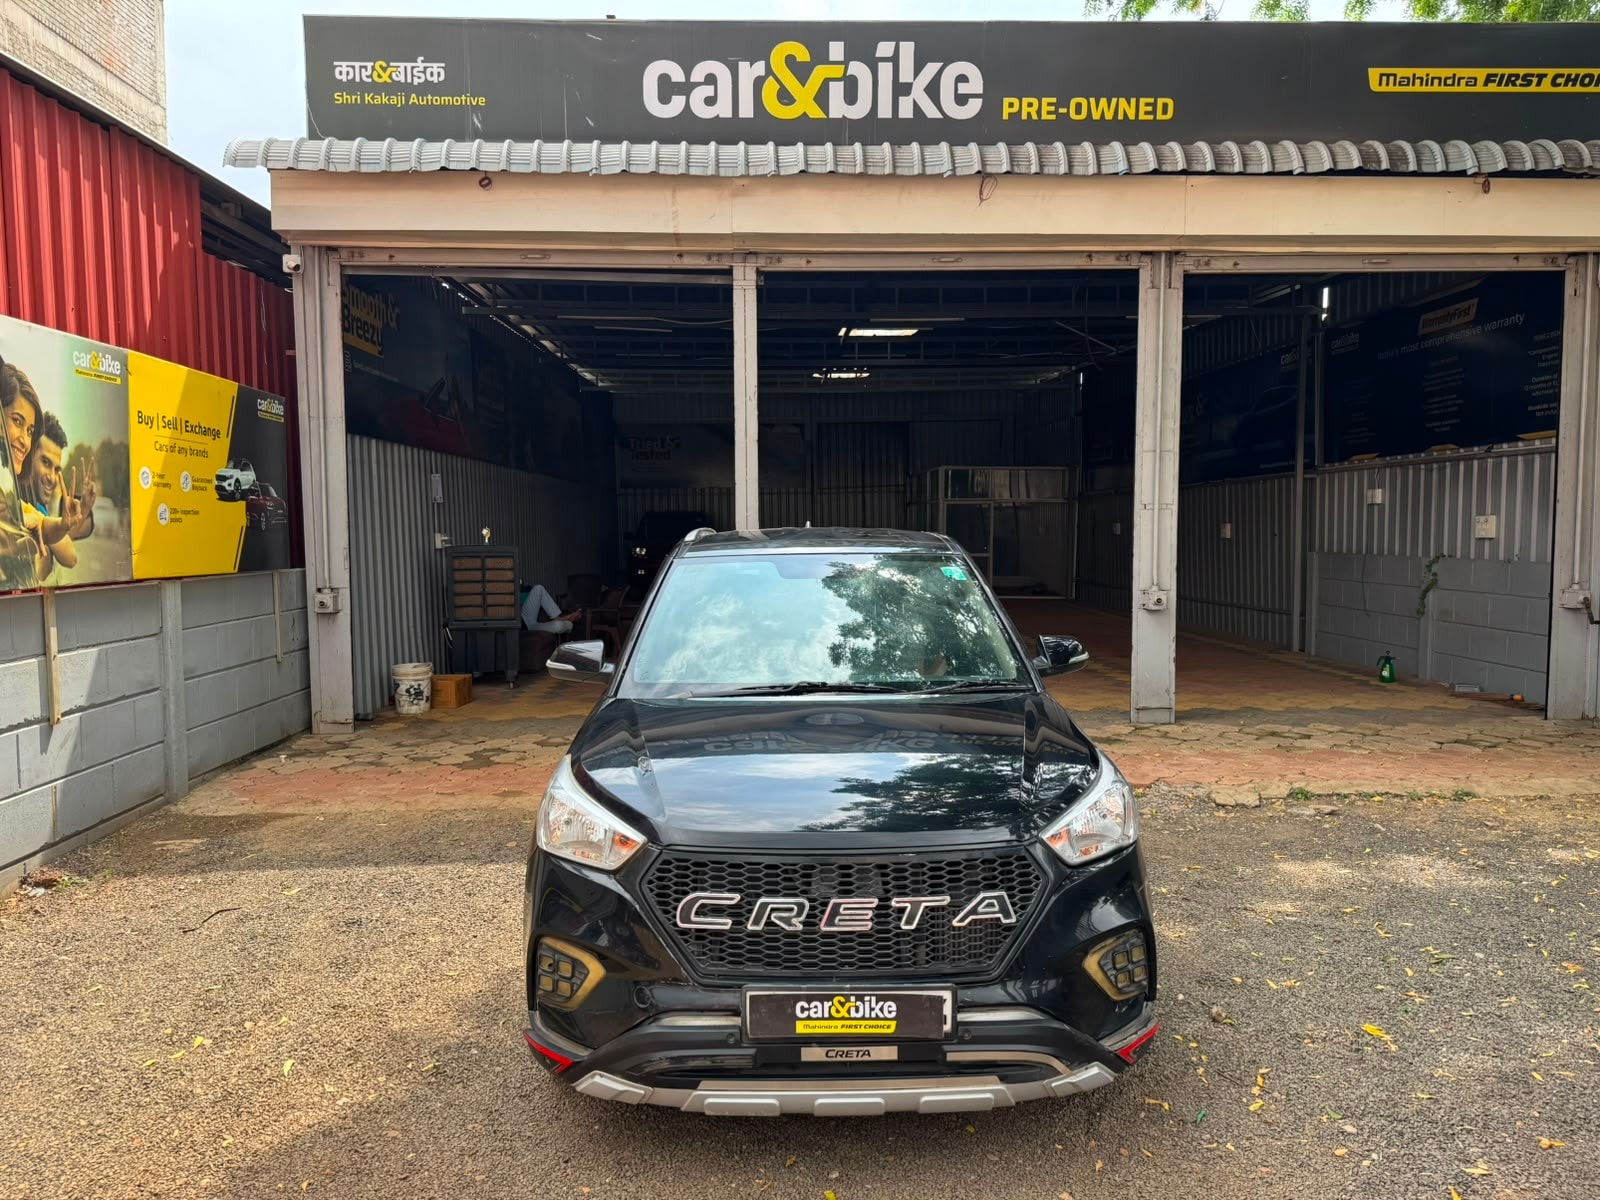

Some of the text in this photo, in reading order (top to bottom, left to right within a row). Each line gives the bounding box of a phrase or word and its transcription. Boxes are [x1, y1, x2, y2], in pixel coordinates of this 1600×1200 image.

[642, 40, 984, 120] car&bike
[1378, 72, 1478, 87] Mahindra
[1482, 72, 1549, 87] FIRST
[334, 92, 486, 107] Shri Kakaji Automotive
[1002, 96, 1175, 121] PRE-OWNED
[1484, 312, 1526, 333] warranty
[72, 351, 121, 375] car&bike
[137, 410, 221, 440] Buy Sell Exchange
[153, 440, 209, 458] Cars of any brands
[675, 890, 1018, 932] CRETA
[795, 995, 897, 1019] car&bike
[825, 1048, 872, 1059] CRETA
